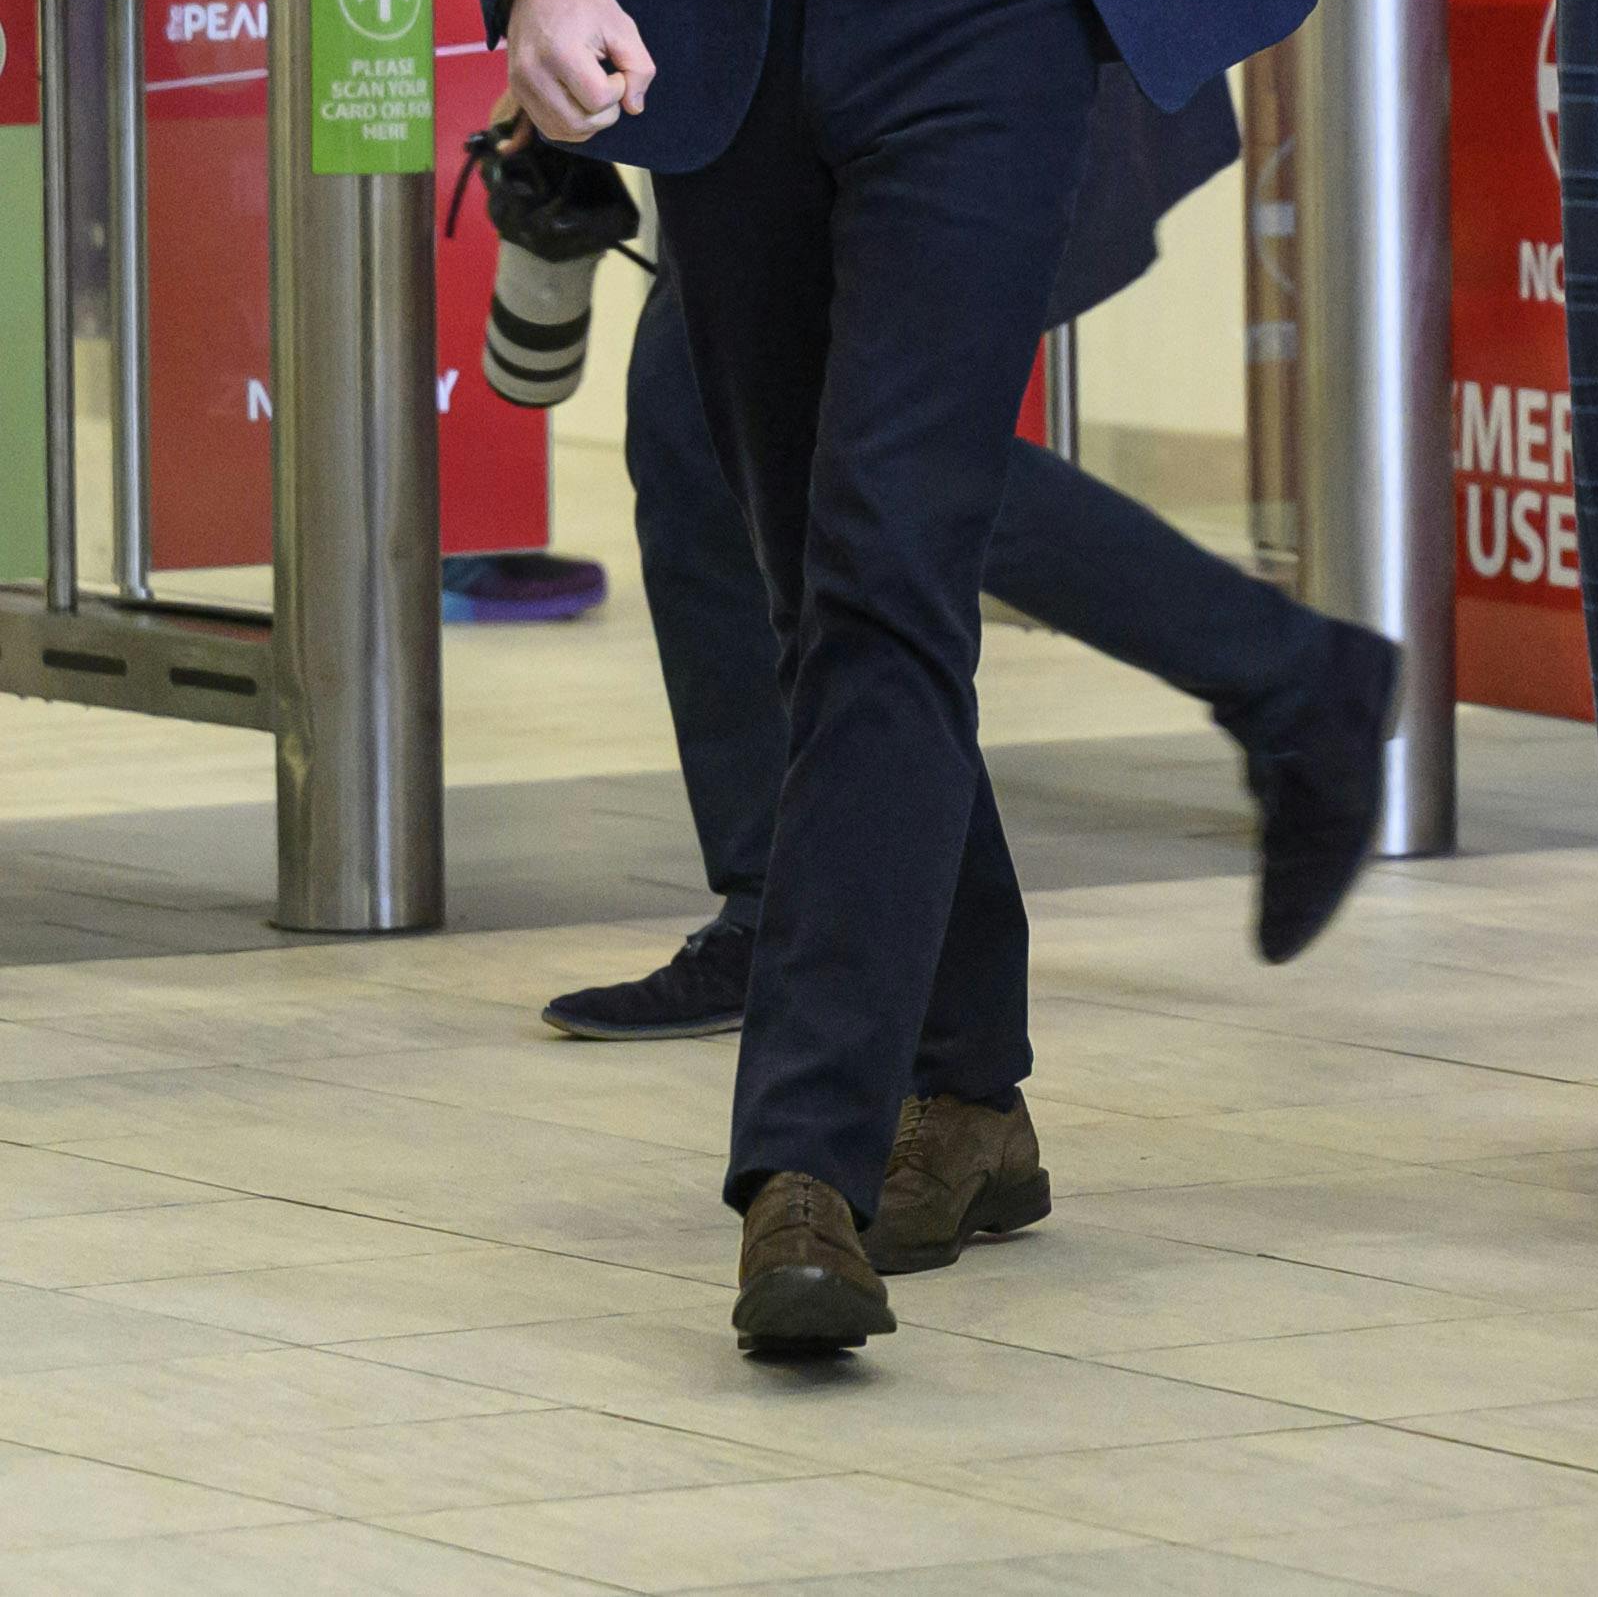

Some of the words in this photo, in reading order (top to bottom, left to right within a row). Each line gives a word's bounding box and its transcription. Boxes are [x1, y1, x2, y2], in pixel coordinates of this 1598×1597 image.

[351, 58, 415, 76] PLEASE
[331, 81, 385, 99] SCAN
[322, 102, 377, 120] CARD
[362, 123, 407, 140] HERE
